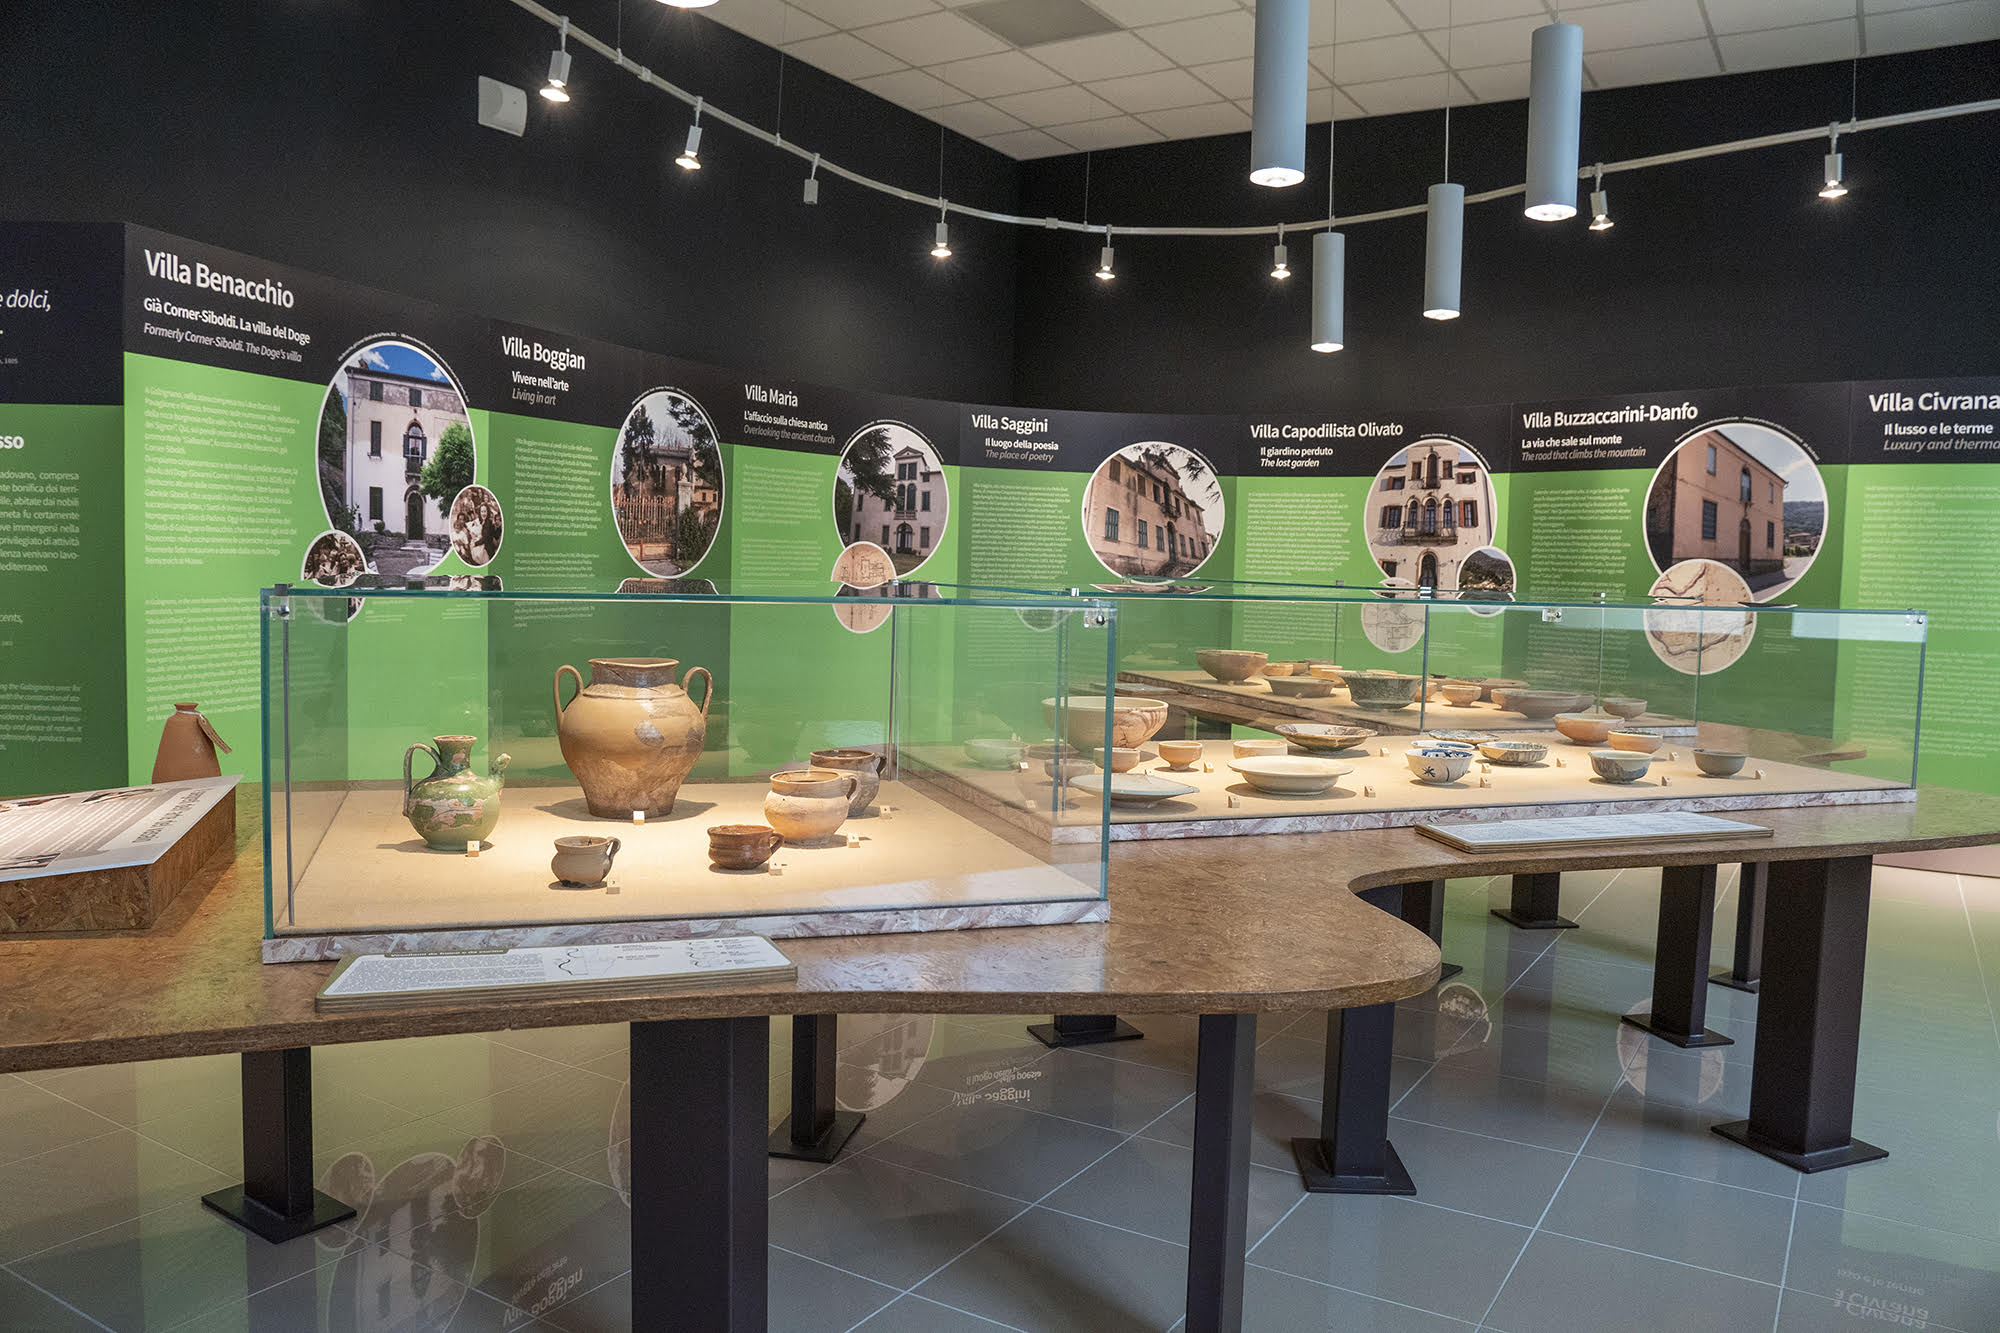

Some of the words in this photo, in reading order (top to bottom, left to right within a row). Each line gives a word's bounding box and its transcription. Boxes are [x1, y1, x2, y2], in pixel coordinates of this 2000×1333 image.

[144, 249, 192, 285] Villa
[196, 262, 295, 308] Benacchio
[6, 289, 51, 312] dolci,
[143, 297, 163, 314] Già
[163, 301, 239, 329] Corner-Siboldi.
[239, 318, 251, 332] La
[251, 321, 272, 336] villa
[272, 325, 287, 340] del
[288, 328, 311, 346] Doge
[144, 322, 185, 343] Formerly
[184, 331, 245, 352] Corner-Siboldi.
[246, 342, 261, 355] The
[260, 346, 287, 360] Doge's
[287, 350, 303, 363] villa
[502, 336, 531, 360] Villa
[533, 342, 586, 372] Boggian
[512, 371, 537, 386] Vivere
[537, 376, 570, 392] nell'arte
[512, 388, 536, 405] Living
[536, 391, 544, 404] in
[544, 393, 557, 406] art
[744, 384, 768, 402] Villa
[769, 388, 799, 408] Maria
[1868, 392, 1914, 412] Villa
[1918, 391, 2000, 411] Civrana
[744, 410, 773, 424] L'affaccio
[772, 414, 788, 426] sulla
[788, 417, 808, 428] chiesa
[808, 420, 828, 432] antica
[972, 414, 999, 430] Villa
[1000, 416, 1049, 436] Saggini
[1523, 412, 1552, 429] Villa
[1554, 402, 1699, 428] Buzzaccarini-Danfo
[744, 424, 780, 440] Overlooking
[780, 428, 791, 440] the
[791, 431, 814, 442] ancient
[814, 433, 836, 444] church
[1250, 424, 1280, 439] Villa
[1282, 422, 1356, 442] Capodilista
[1358, 422, 1404, 437] Olivato
[1884, 423, 1893, 436] Il
[1894, 423, 1928, 436] lusso
[1928, 425, 1938, 435] e
[1940, 422, 1952, 435] le
[1953, 423, 1994, 435] terme
[985, 438, 991, 447] Il
[990, 438, 1013, 450] luogo
[1013, 439, 1033, 449] della
[1032, 441, 1059, 452] poesia
[1521, 438, 1532, 449] La
[1532, 438, 1545, 448] via
[1545, 436, 1561, 448] che
[1561, 436, 1578, 447] sale
[1578, 436, 1592, 446] sul
[1592, 434, 1622, 446] monte
[1883, 439, 1926, 453] Luxury
[1926, 438, 1954, 451] and
[985, 450, 999, 458] The
[998, 450, 1018, 460] place
[1018, 450, 1029, 461] of
[1028, 452, 1054, 464] poetry
[1260, 446, 1266, 456] Il
[1266, 446, 1300, 458] giardino
[1301, 446, 1334, 458] perduto
[1521, 452, 1535, 462] The
[1535, 450, 1552, 461] road
[1552, 450, 1568, 460] that
[1568, 448, 1592, 460] climbs
[1592, 448, 1607, 459] the
[1607, 446, 1646, 458] mountain
[1260, 458, 1275, 467] The
[1275, 458, 1291, 467] lost
[1290, 459, 1320, 470] garden
